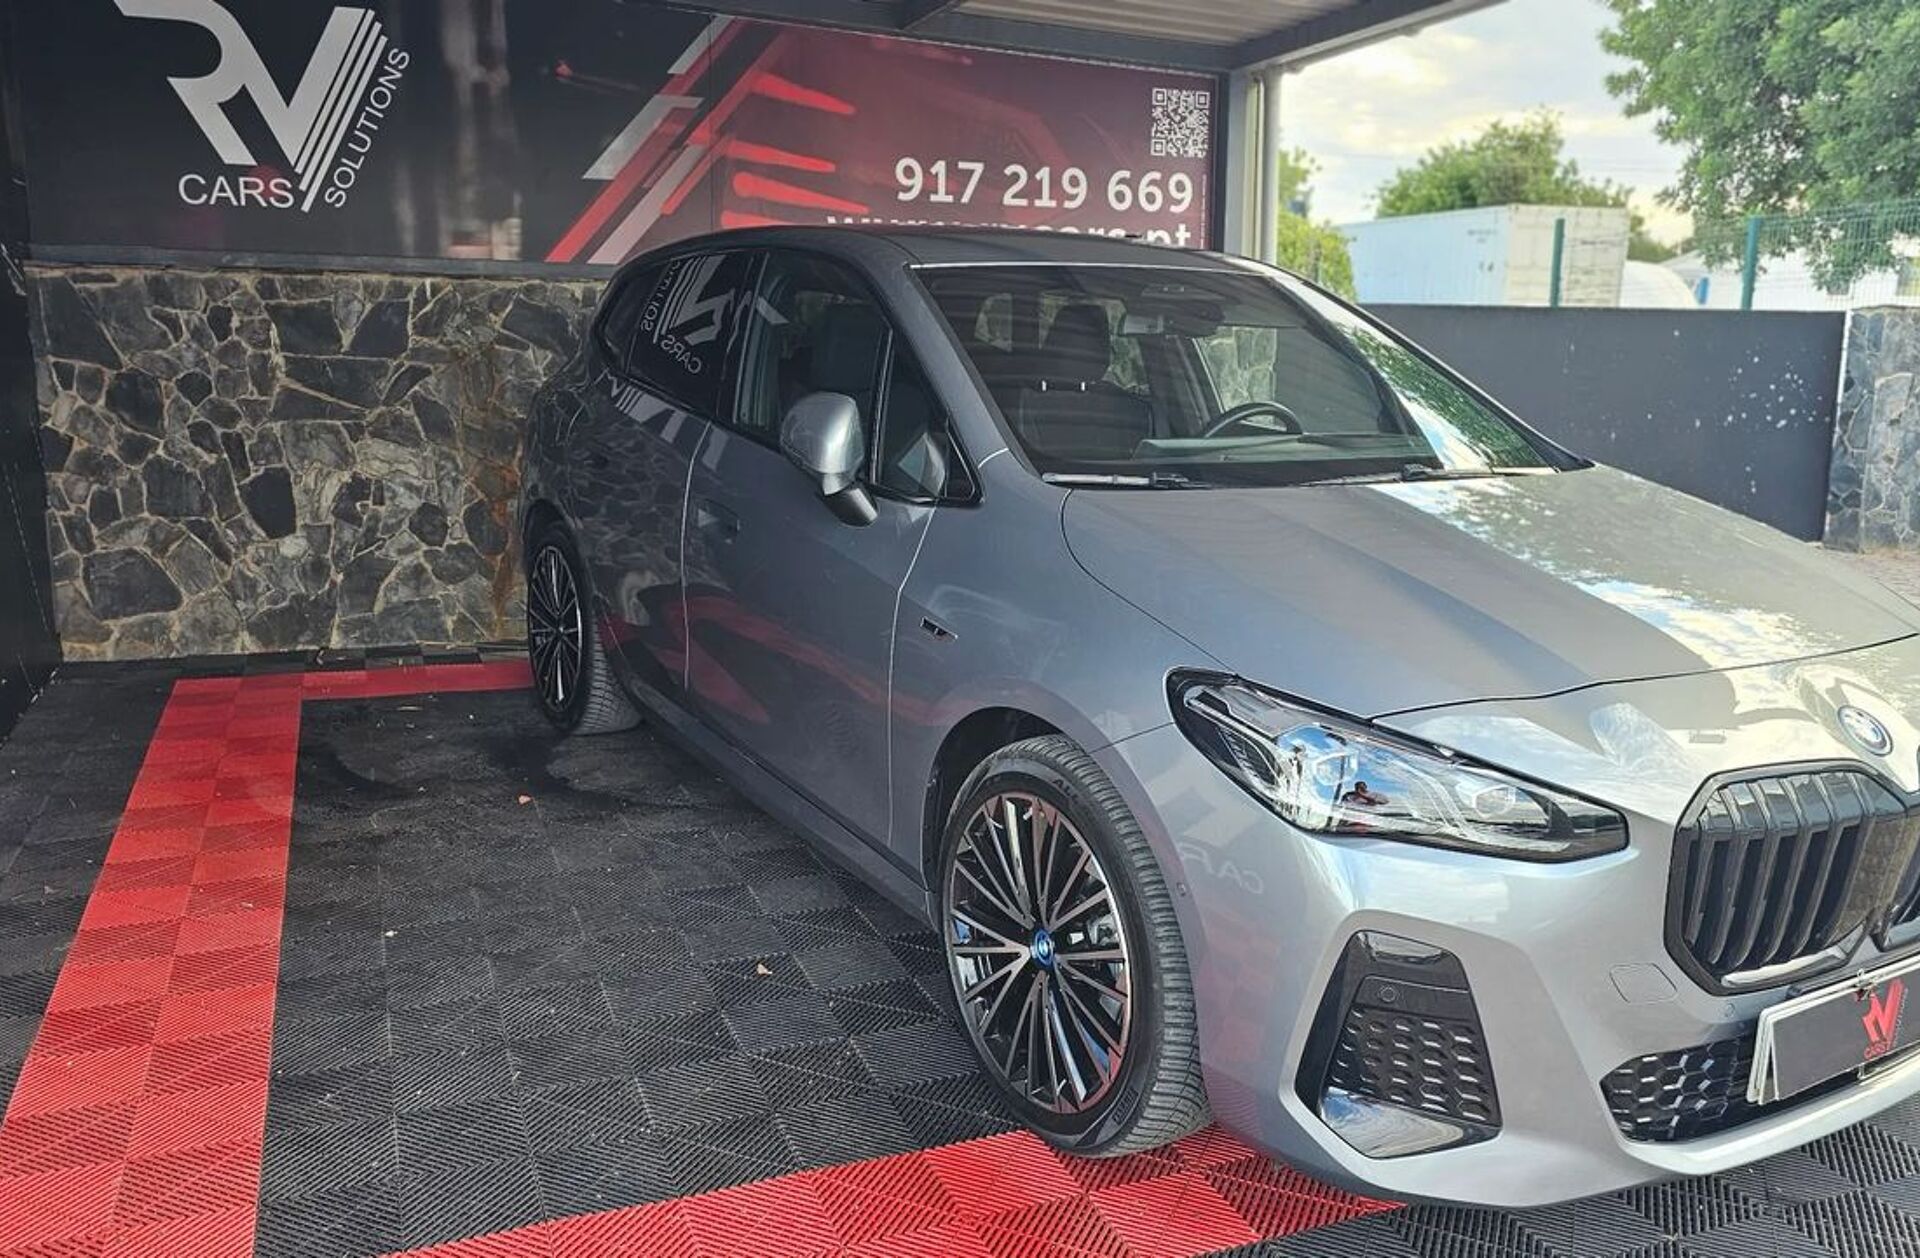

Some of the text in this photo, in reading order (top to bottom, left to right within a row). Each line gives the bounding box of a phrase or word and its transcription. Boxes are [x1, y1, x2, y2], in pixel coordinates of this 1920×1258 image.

[325, 48, 410, 208] SOLUTIONS
[178, 174, 294, 208] CARS
[894, 157, 1193, 213] 917 219 669
